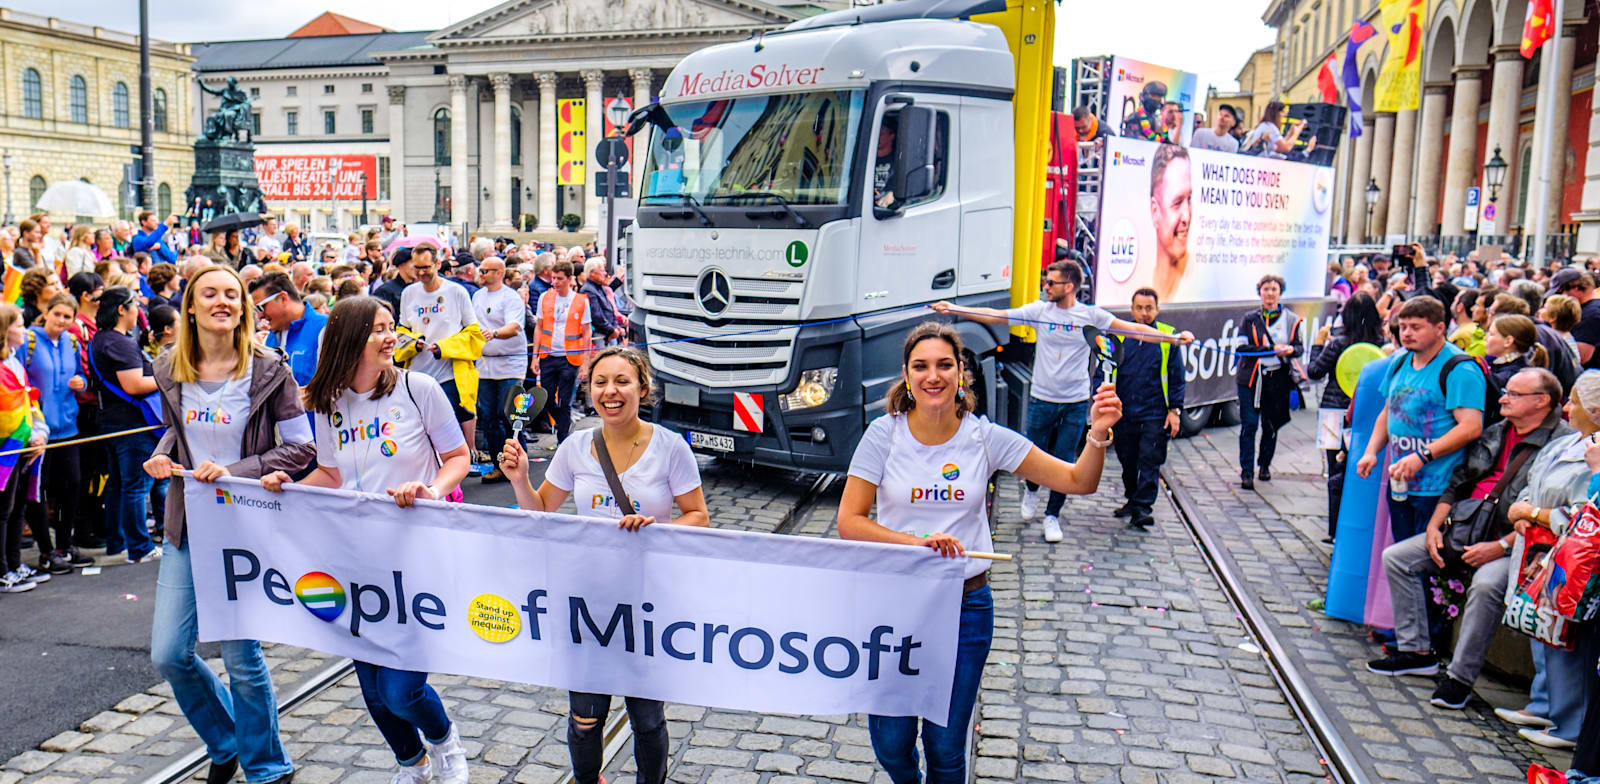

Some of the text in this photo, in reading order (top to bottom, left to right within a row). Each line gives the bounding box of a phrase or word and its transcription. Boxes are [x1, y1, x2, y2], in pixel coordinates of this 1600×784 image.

[678, 64, 825, 97] MediaSolver
[255, 159, 277, 170] WIR
[280, 158, 327, 170] SPIELEN
[1122, 155, 1145, 166] Microsoft
[1202, 162, 1281, 188] WHAT DOES PRIDE
[292, 183, 311, 196] BIS
[1200, 186, 1290, 210] MEAN TO YOU SVEN?
[790, 244, 802, 264] L
[1111, 236, 1135, 256] LIVE
[417, 304, 445, 317] pride
[185, 407, 232, 425] pride
[338, 416, 396, 451] pride
[691, 432, 732, 449] GAP MS 432
[1391, 433, 1438, 451] POIN
[911, 484, 965, 503] pride
[232, 495, 282, 512] Microsoft
[591, 493, 641, 513] prie
[475, 601, 514, 618] Stand up
[478, 612, 510, 623] against
[471, 617, 516, 635] inequality
[568, 596, 922, 681] Microsoft
